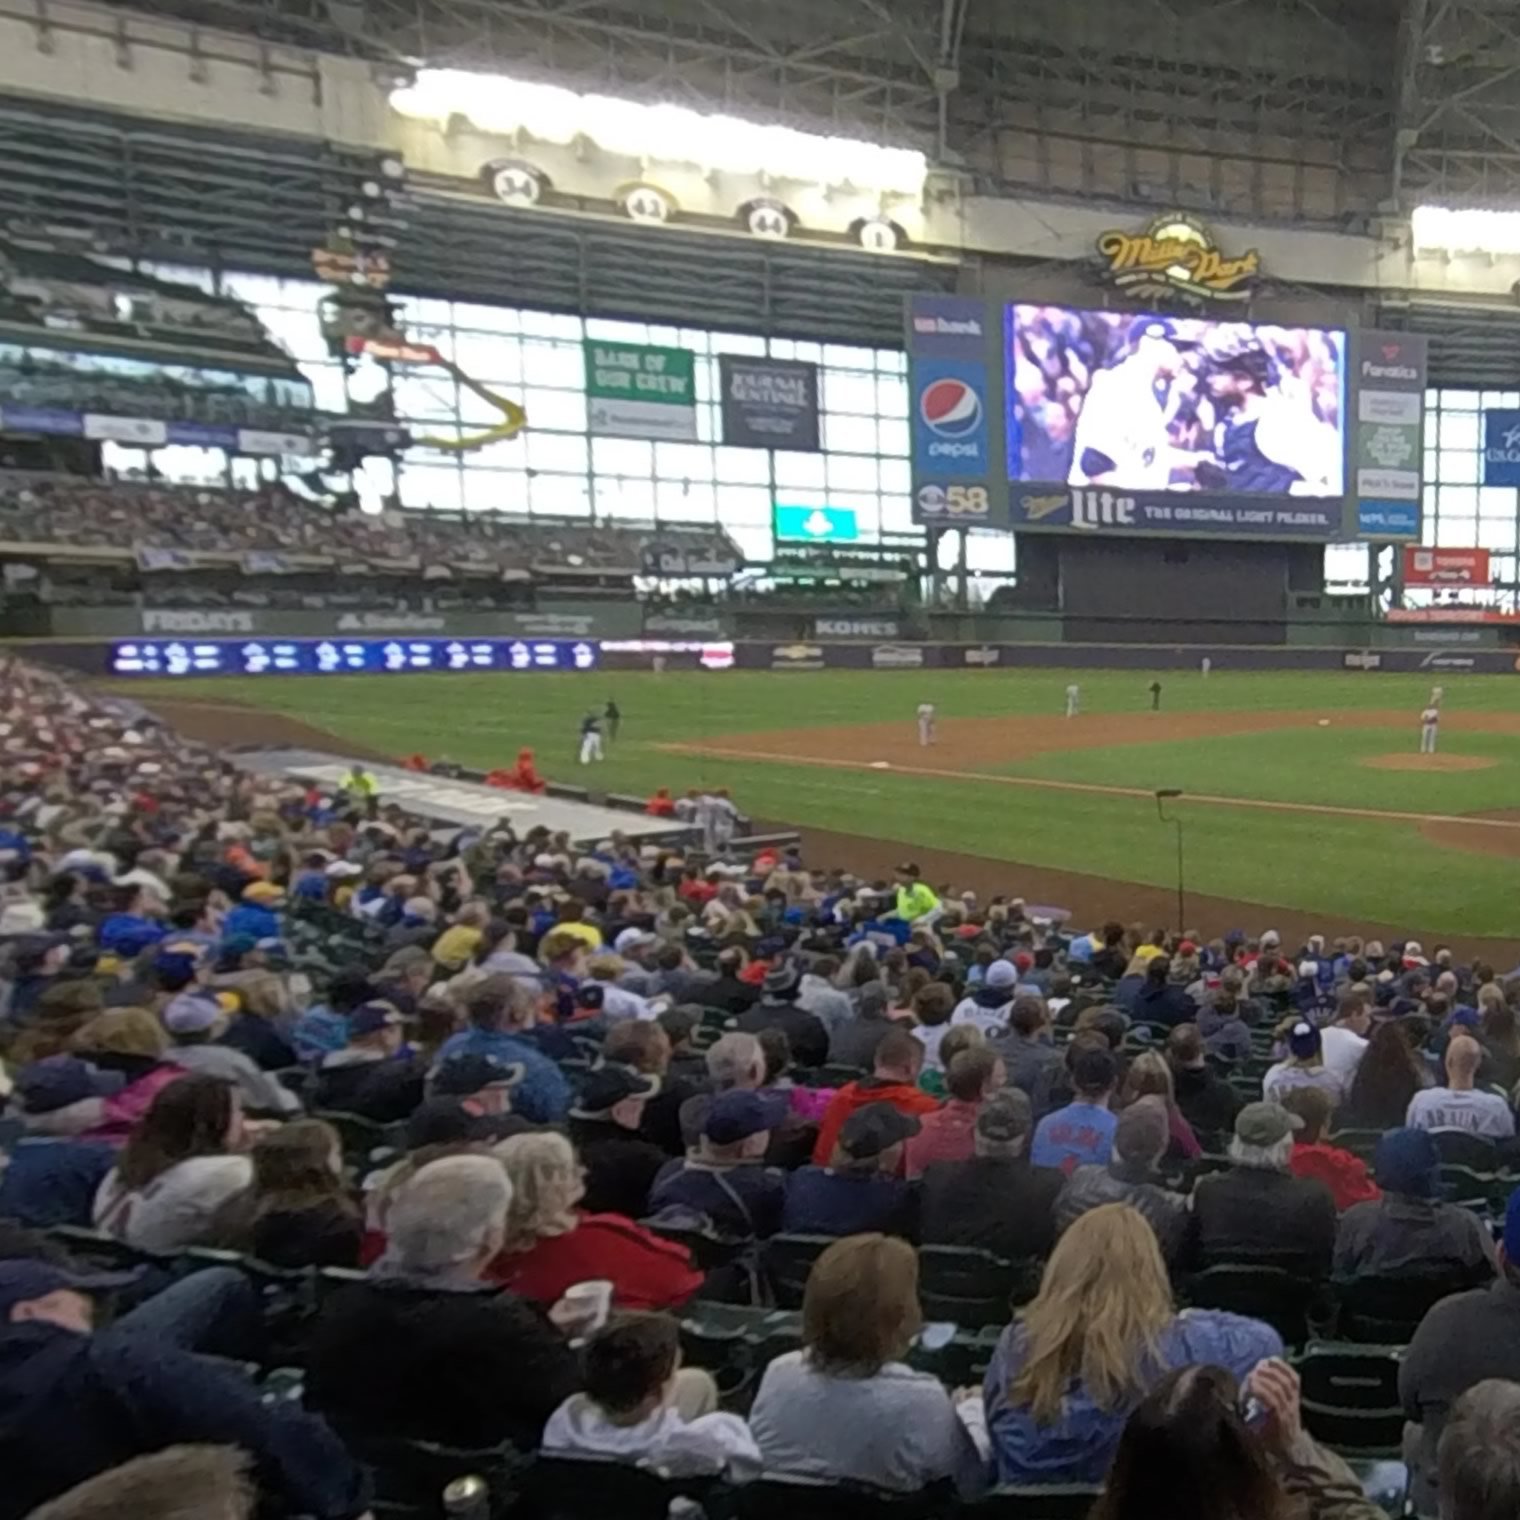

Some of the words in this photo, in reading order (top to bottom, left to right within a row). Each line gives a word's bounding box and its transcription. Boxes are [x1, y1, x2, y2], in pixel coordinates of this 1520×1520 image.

[503, 177, 532, 197] 34
[644, 354, 666, 372] OF
[636, 372, 688, 394] CREW
[945, 486, 989, 514] 58
